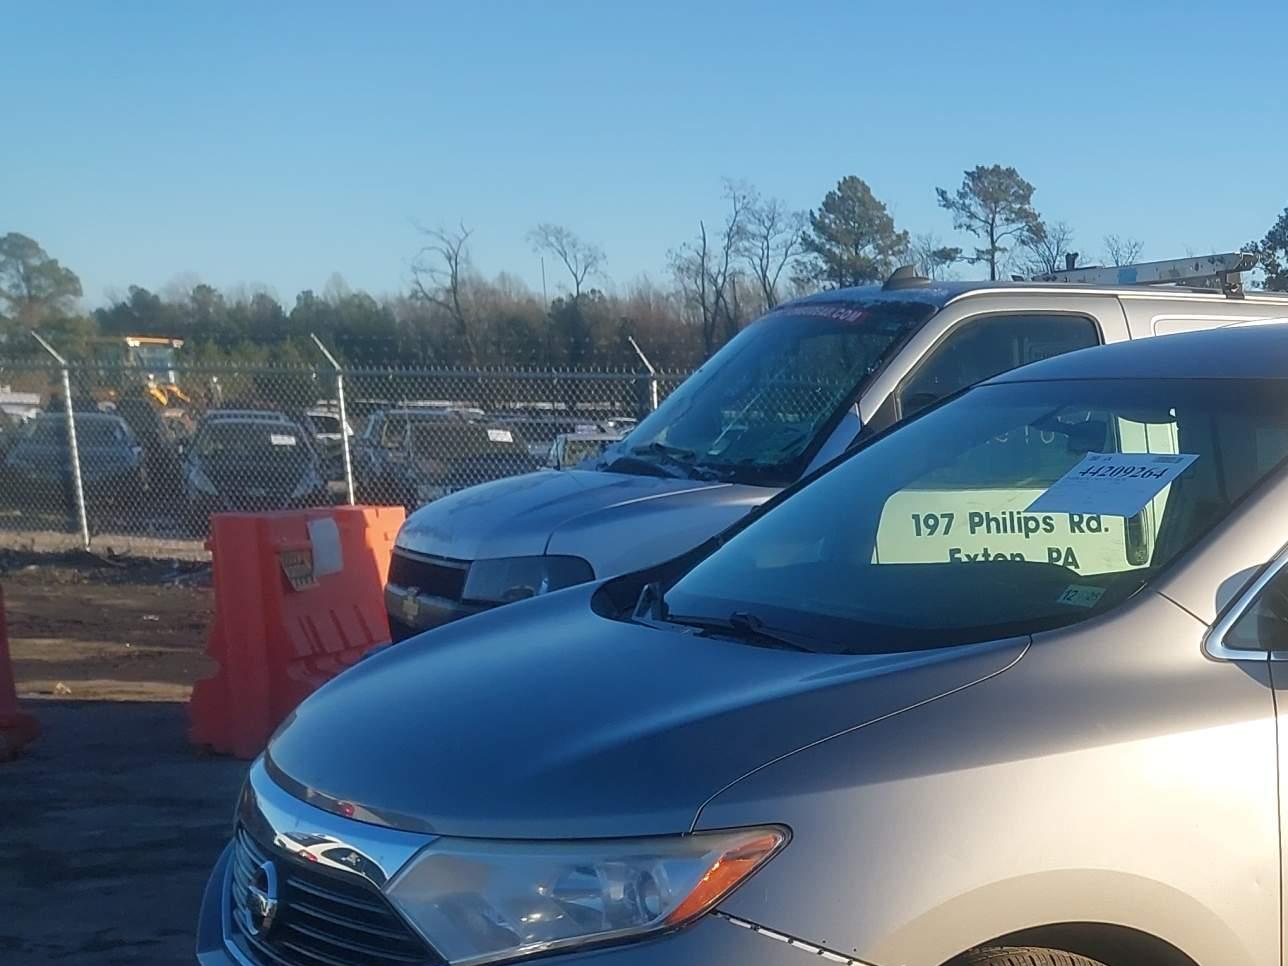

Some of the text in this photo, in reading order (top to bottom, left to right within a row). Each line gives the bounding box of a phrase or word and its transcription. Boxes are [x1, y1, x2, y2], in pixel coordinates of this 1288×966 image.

[1079, 465, 1169, 479] 44209264
[911, 511, 1110, 539] 197 Philips Rd.
[1047, 547, 1080, 570] PA
